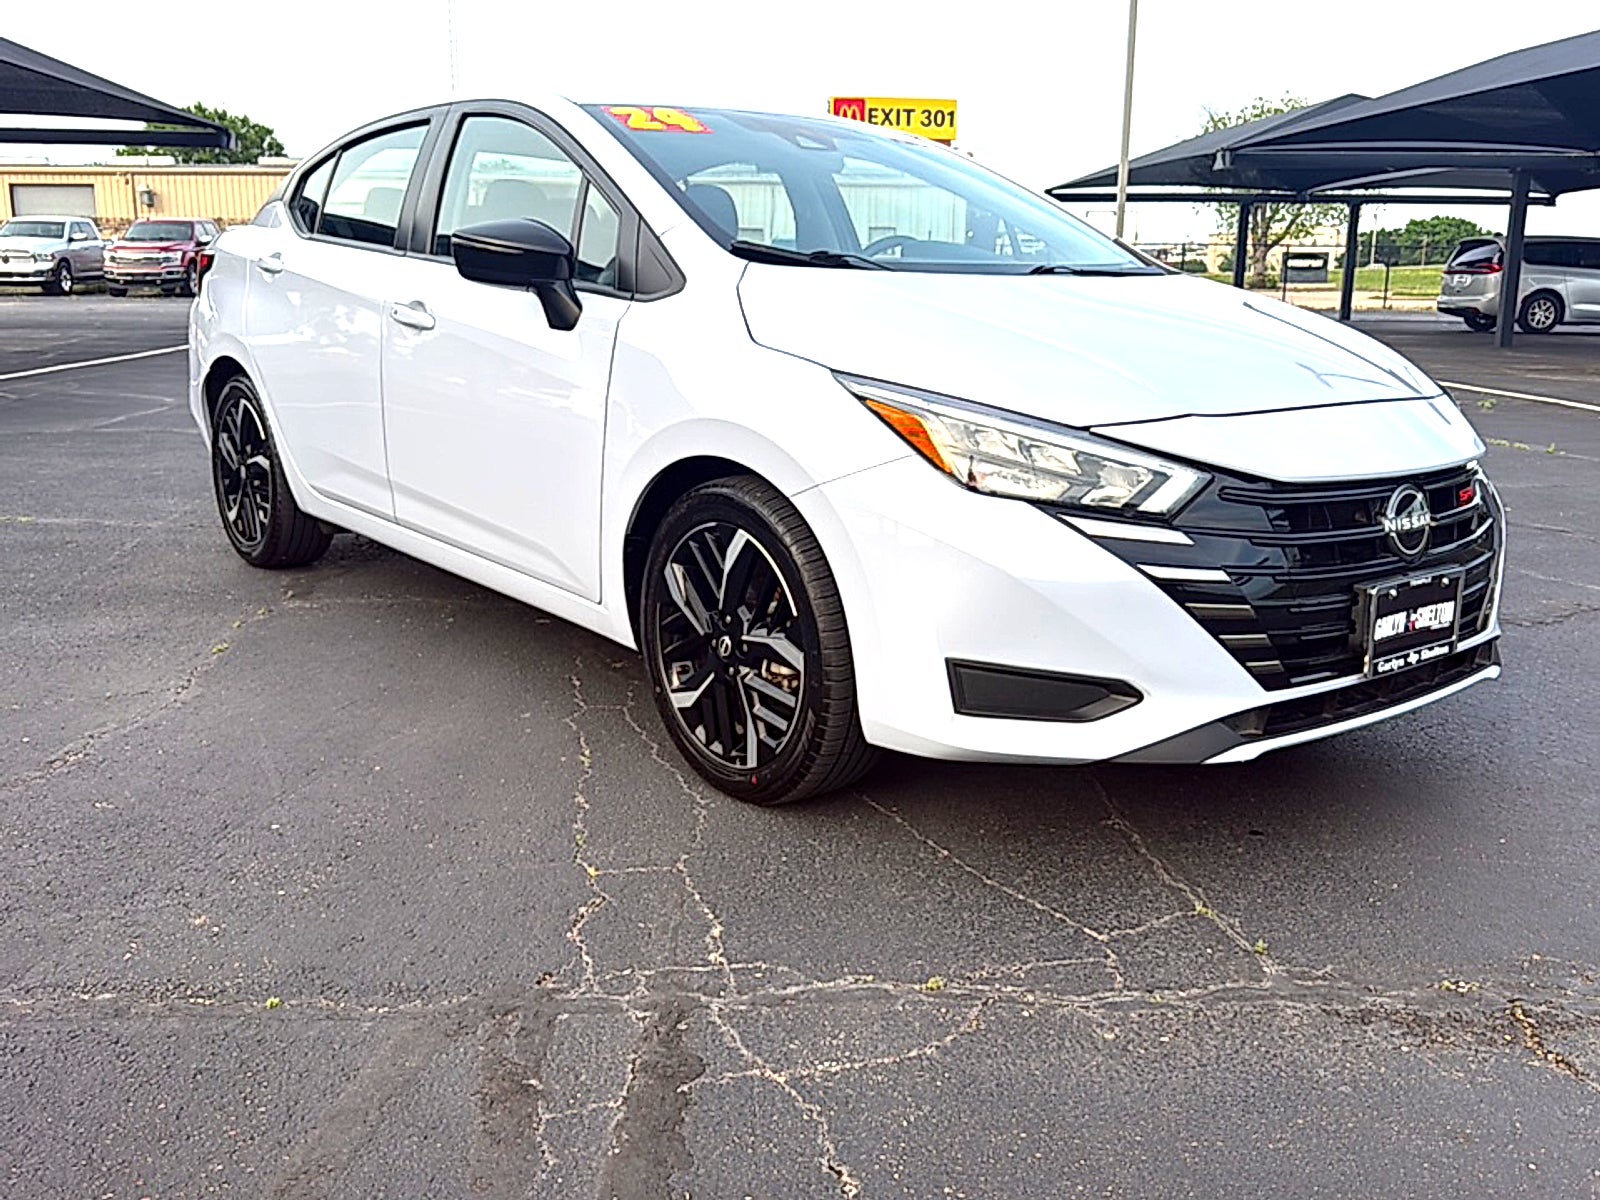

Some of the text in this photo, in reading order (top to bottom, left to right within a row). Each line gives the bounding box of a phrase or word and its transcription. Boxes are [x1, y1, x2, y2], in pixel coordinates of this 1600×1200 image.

[867, 107, 955, 128] EXIT 301
[1384, 511, 1431, 533] NISSAN
